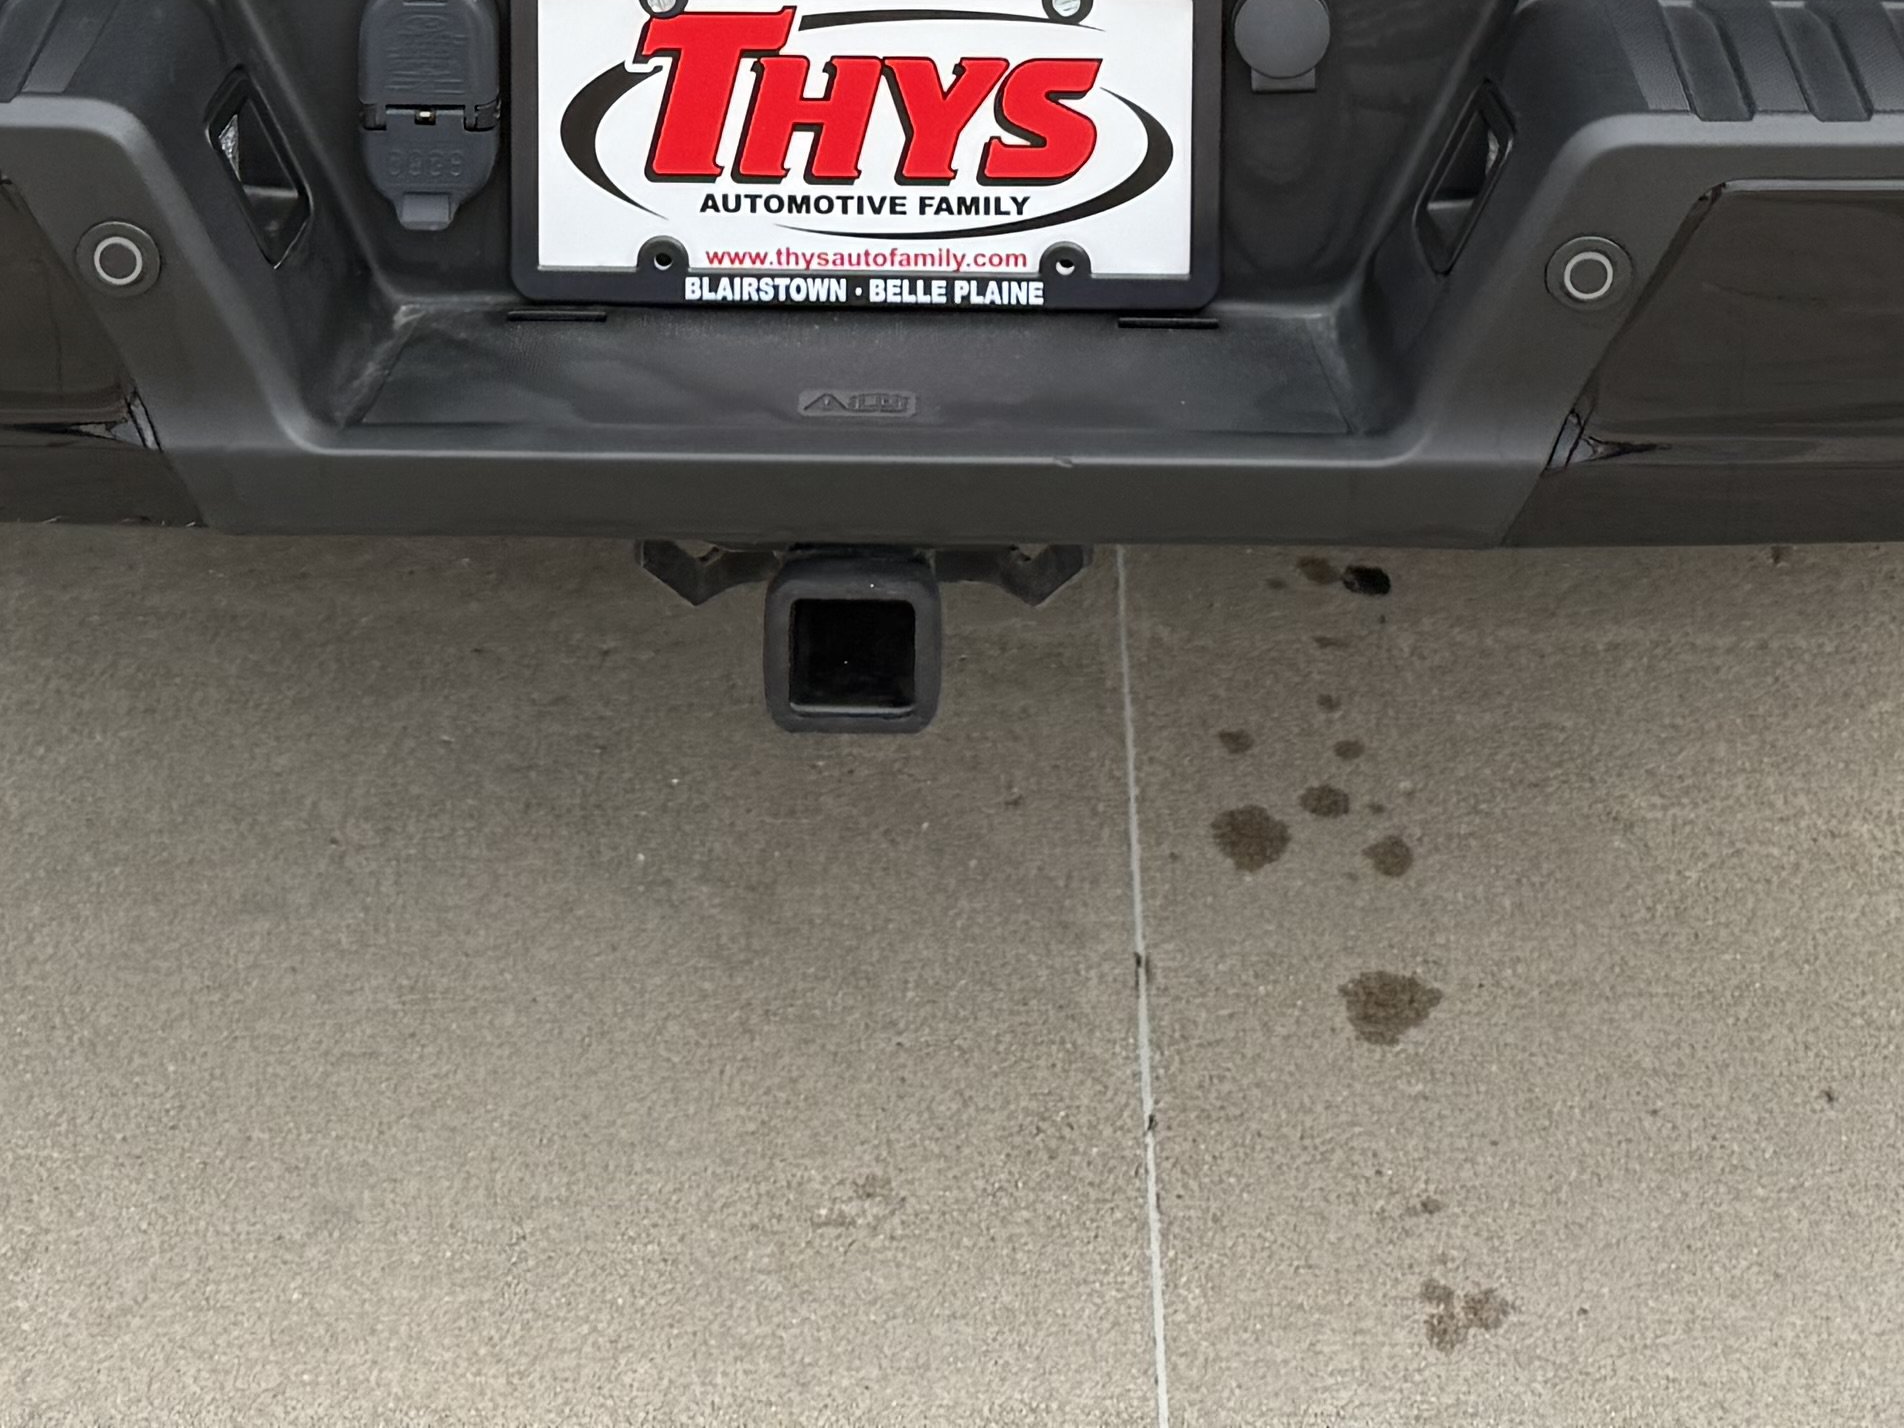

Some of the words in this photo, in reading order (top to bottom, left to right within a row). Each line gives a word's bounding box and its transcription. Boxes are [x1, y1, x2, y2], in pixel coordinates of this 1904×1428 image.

[633, 6, 1103, 186] THYS
[700, 193, 907, 216] AUTOMOTIVE
[918, 195, 1032, 217] FAMILY
[705, 247, 1028, 273] www.thysautofamily.com
[684, 276, 847, 303] BLAIRSTOWN
[869, 281, 947, 304] BELLE
[954, 282, 1045, 305] PLAINE
